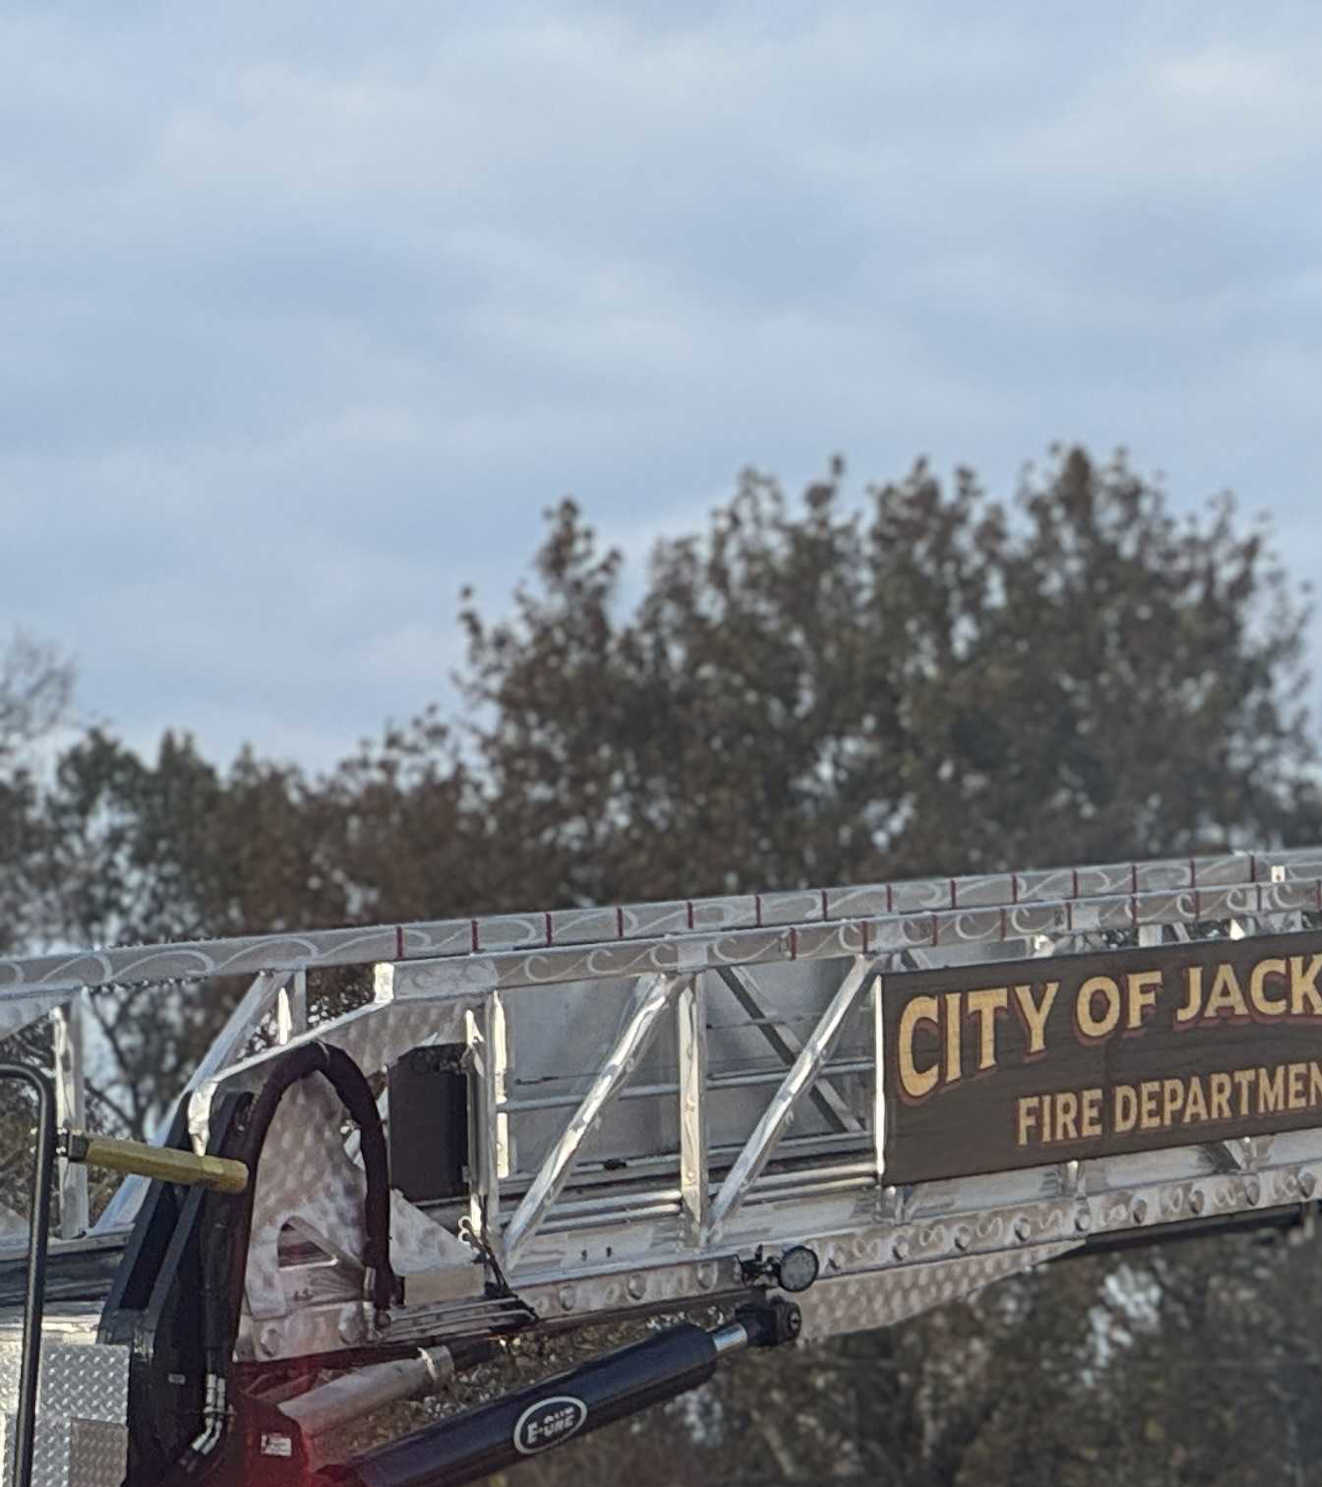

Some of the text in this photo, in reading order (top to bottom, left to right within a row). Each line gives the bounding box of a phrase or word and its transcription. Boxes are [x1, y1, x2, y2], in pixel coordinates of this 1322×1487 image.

[897, 982, 1060, 1098] CITY
[1074, 971, 1164, 1038] OF
[1017, 1087, 1104, 1147] FIRE
